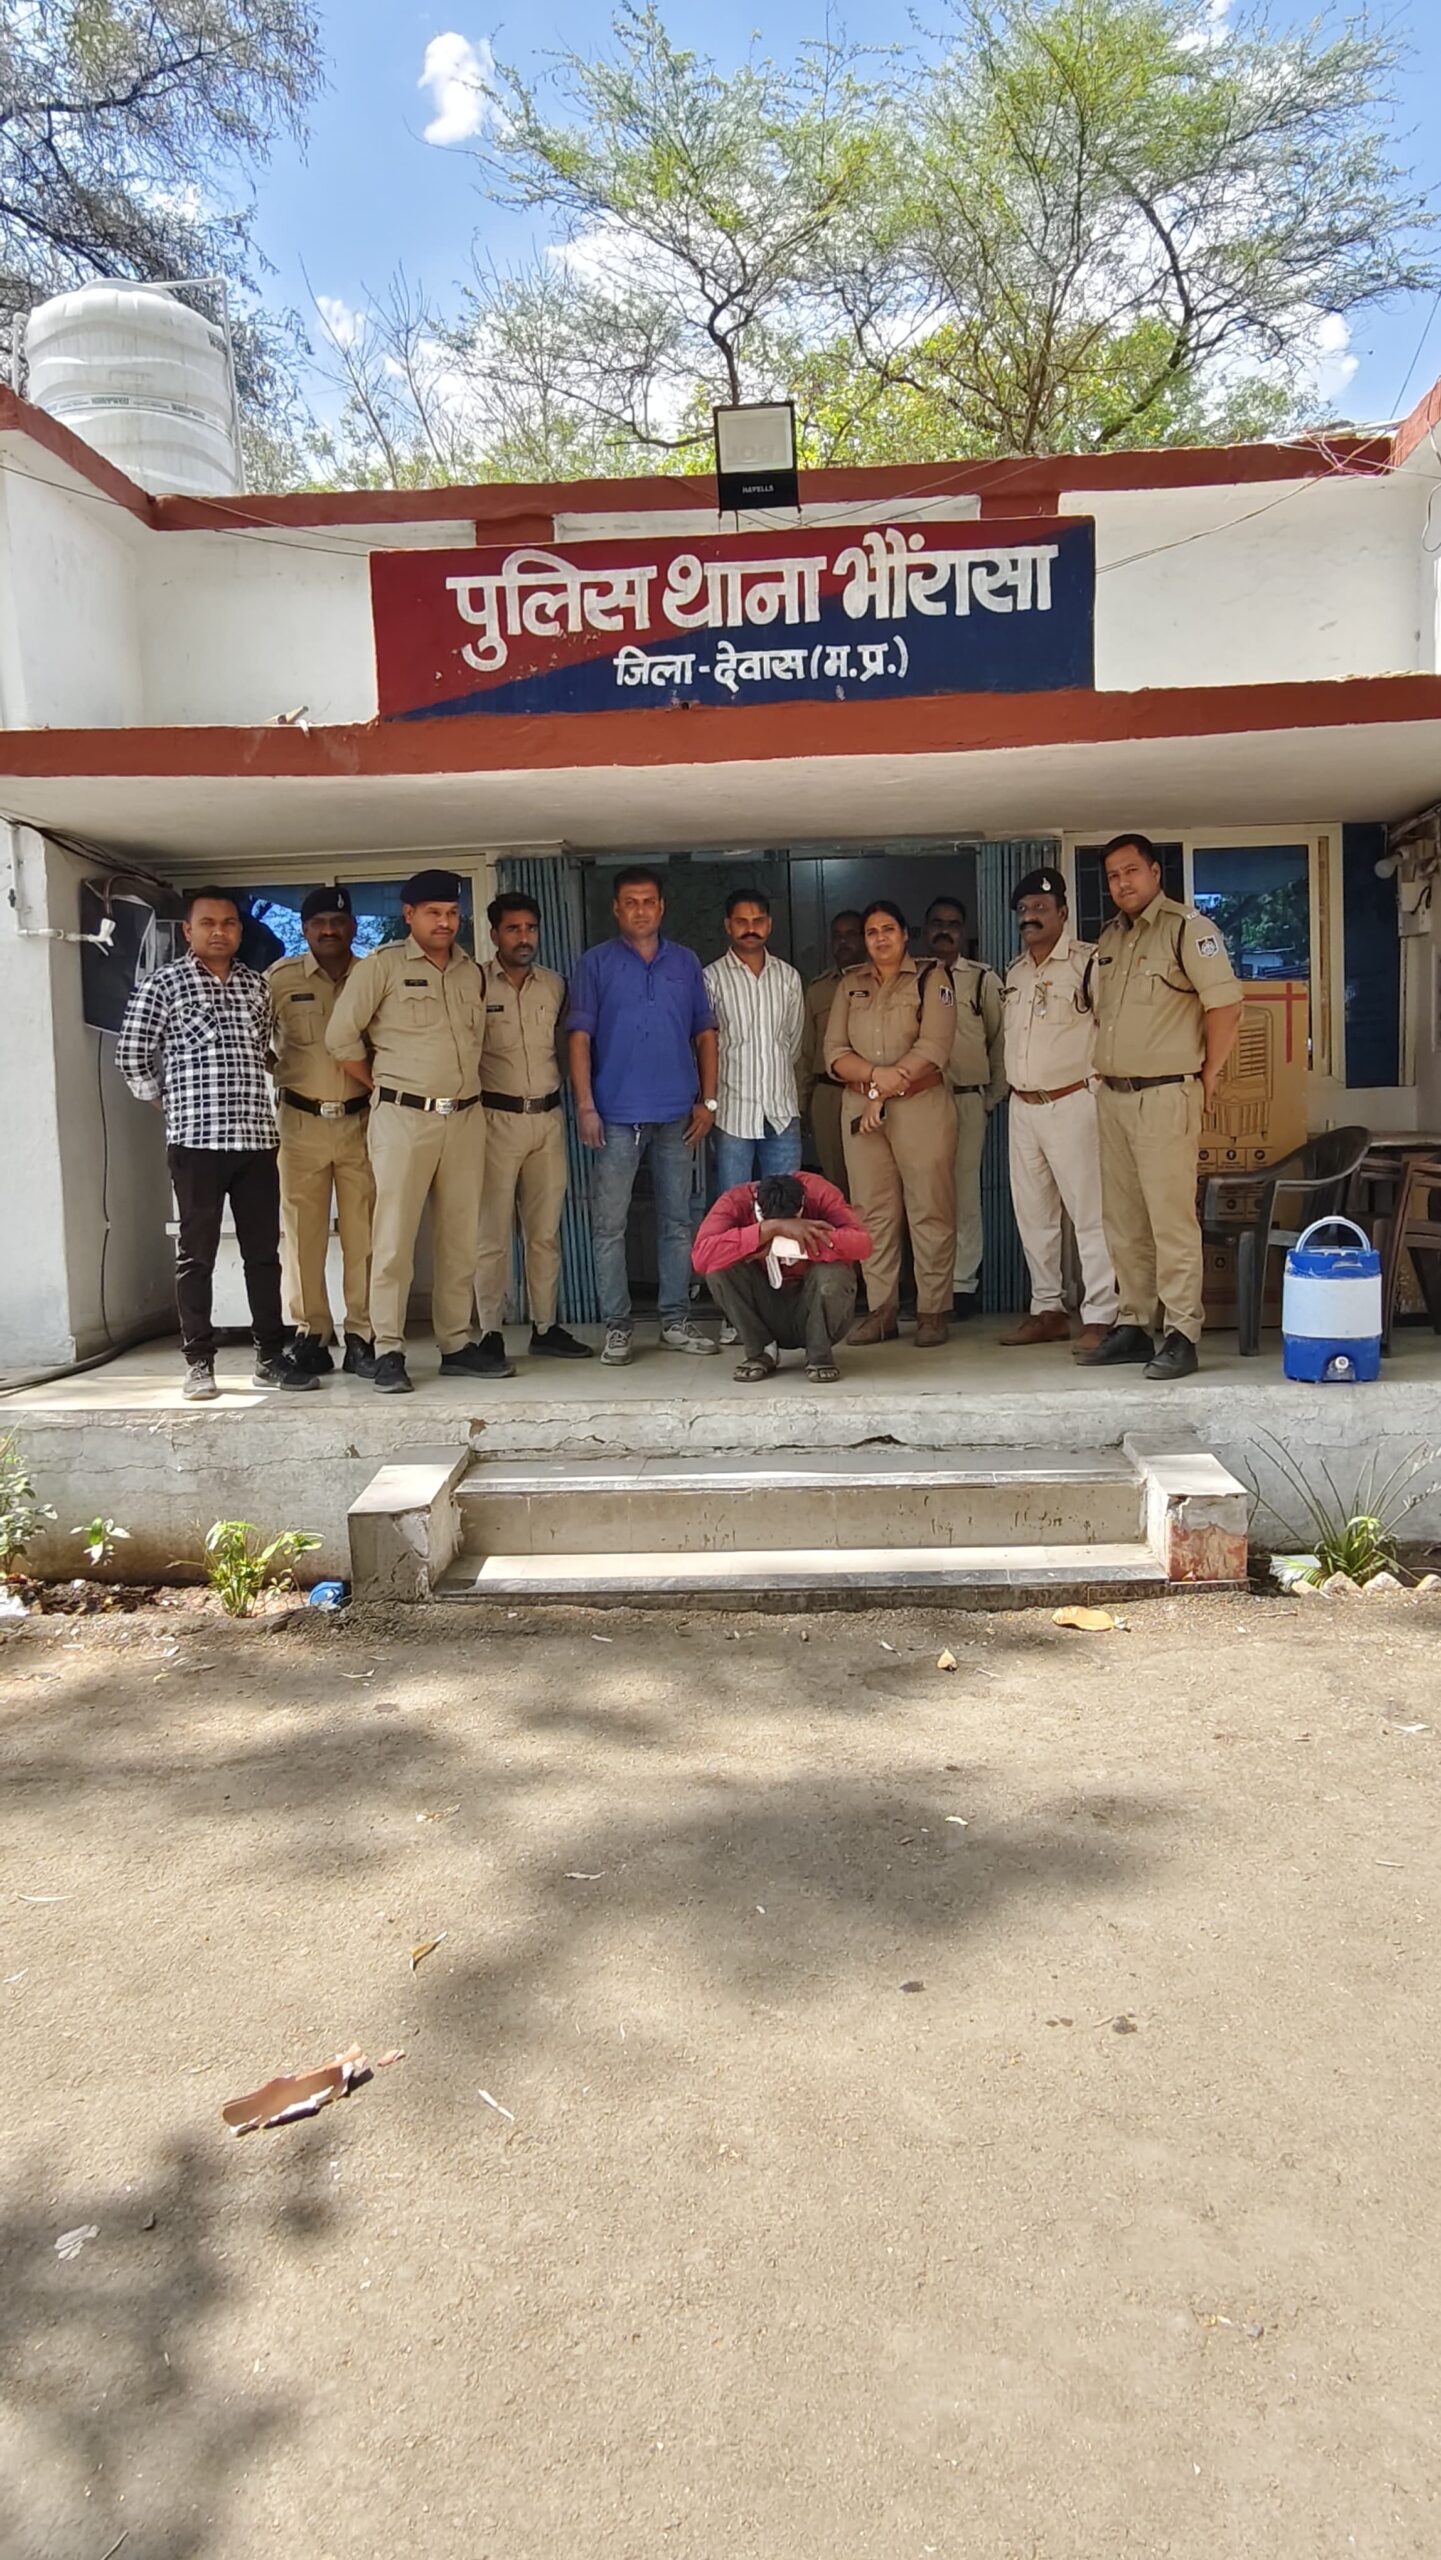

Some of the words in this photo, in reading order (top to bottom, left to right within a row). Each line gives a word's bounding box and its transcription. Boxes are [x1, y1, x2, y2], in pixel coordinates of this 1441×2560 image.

[742, 485, 774, 493] HAVELLS
[446, 549, 657, 672] पुलिस
[663, 554, 827, 629] थाना
[832, 528, 1059, 619] भौंरासा
